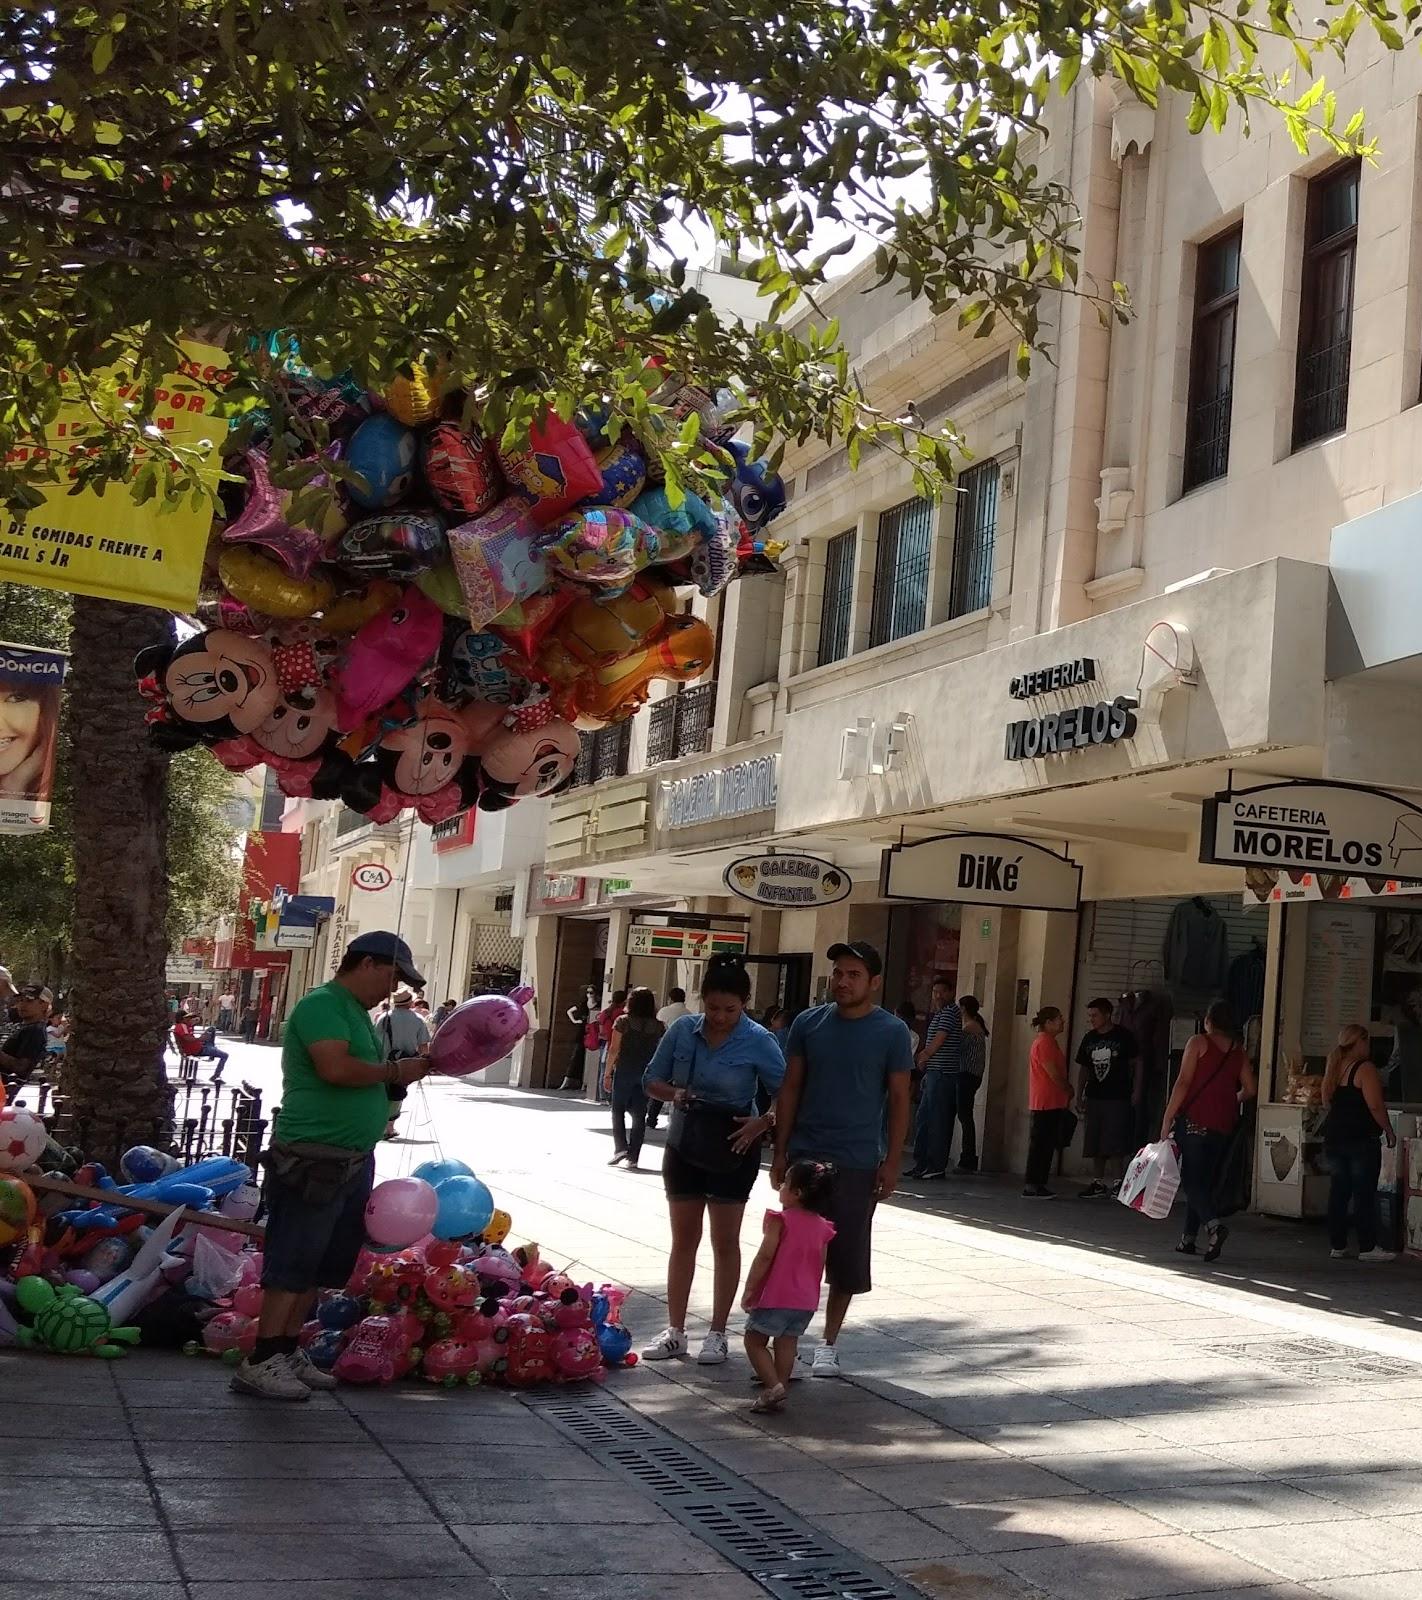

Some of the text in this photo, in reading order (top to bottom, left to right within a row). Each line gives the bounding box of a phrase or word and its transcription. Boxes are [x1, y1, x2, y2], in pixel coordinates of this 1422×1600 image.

[8, 520, 163, 563] DE COMIDAS FRENTE A
[1009, 657, 1096, 701] CAFETERIA
[1004, 696, 1139, 761] MORELOS
[1234, 802, 1326, 826] CAFETERIA
[1233, 829, 1383, 867] MORELOS
[361, 869, 386, 884] C&A
[760, 860, 820, 880] GALERIA
[957, 853, 1024, 893] DiKé
[757, 881, 817, 902] INFANTIL
[634, 936, 646, 946] 24
[688, 933, 708, 957] 7
